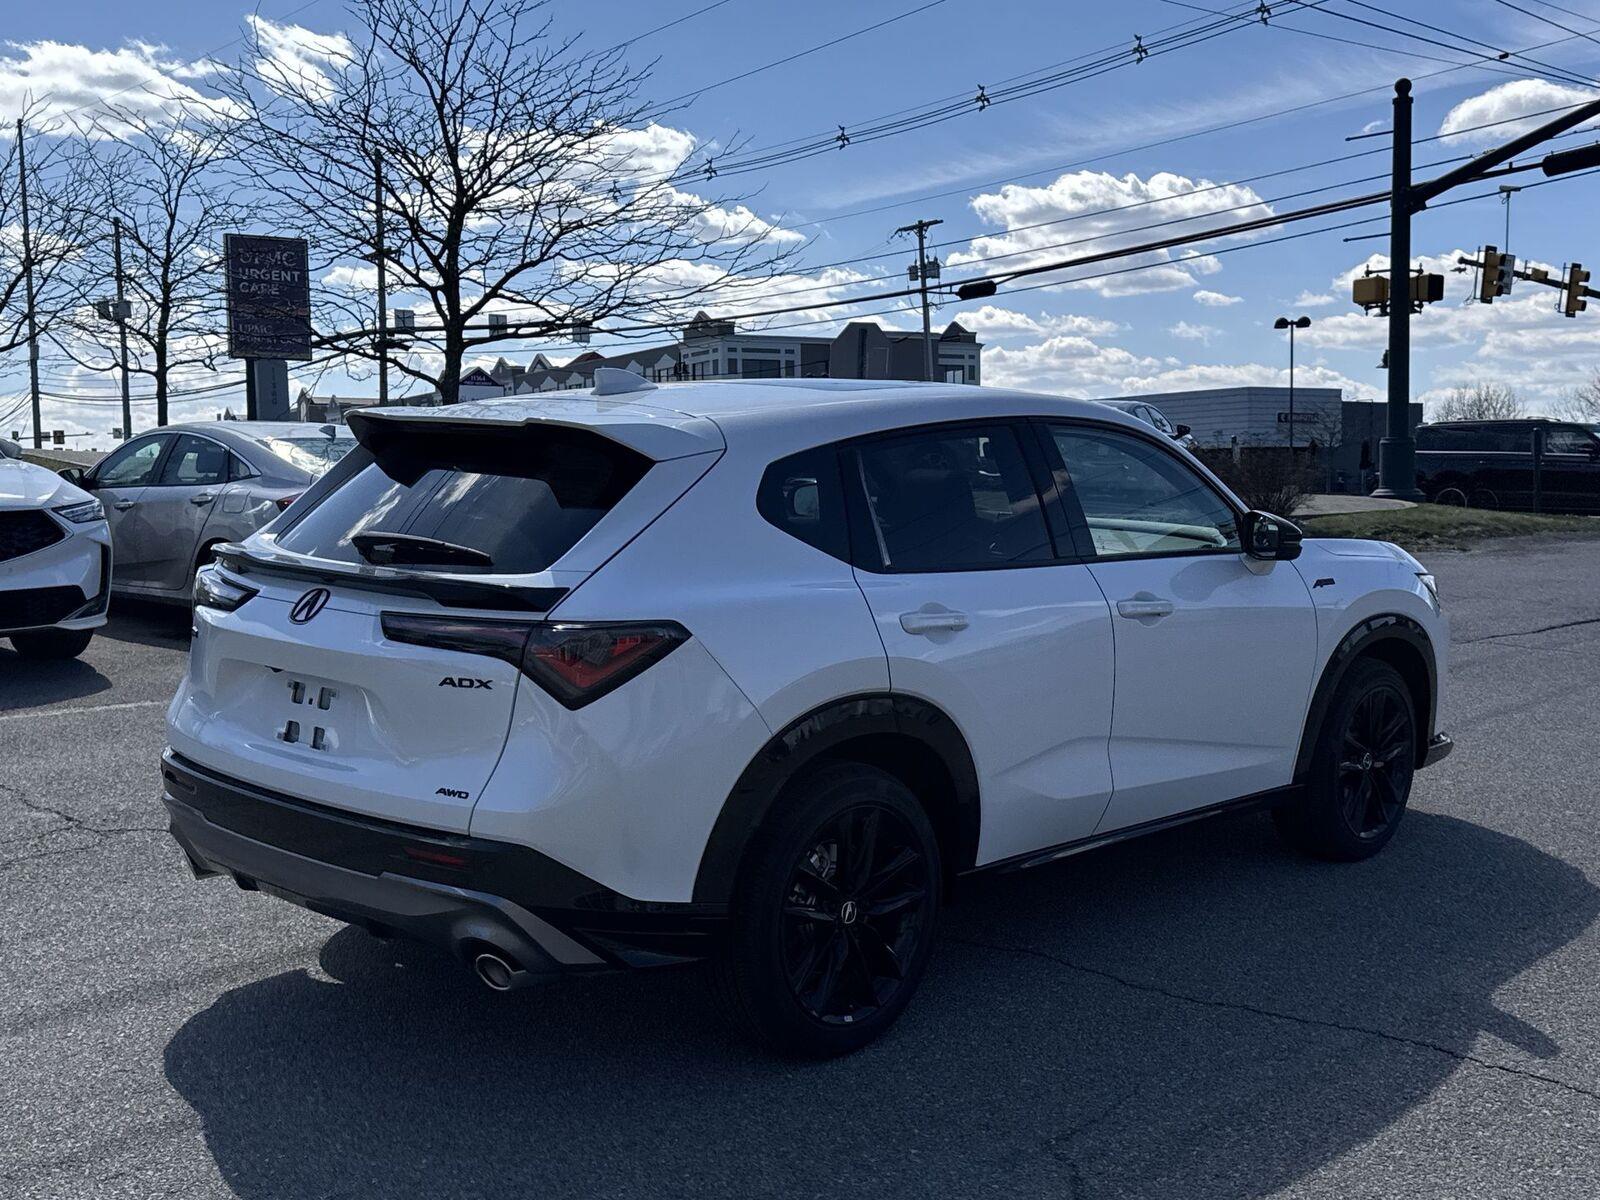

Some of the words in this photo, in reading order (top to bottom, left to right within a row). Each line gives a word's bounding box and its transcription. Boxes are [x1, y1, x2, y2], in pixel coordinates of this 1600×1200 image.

[239, 267, 301, 283] URGENT
[438, 677, 493, 690] ADX
[435, 787, 470, 800] AWD
